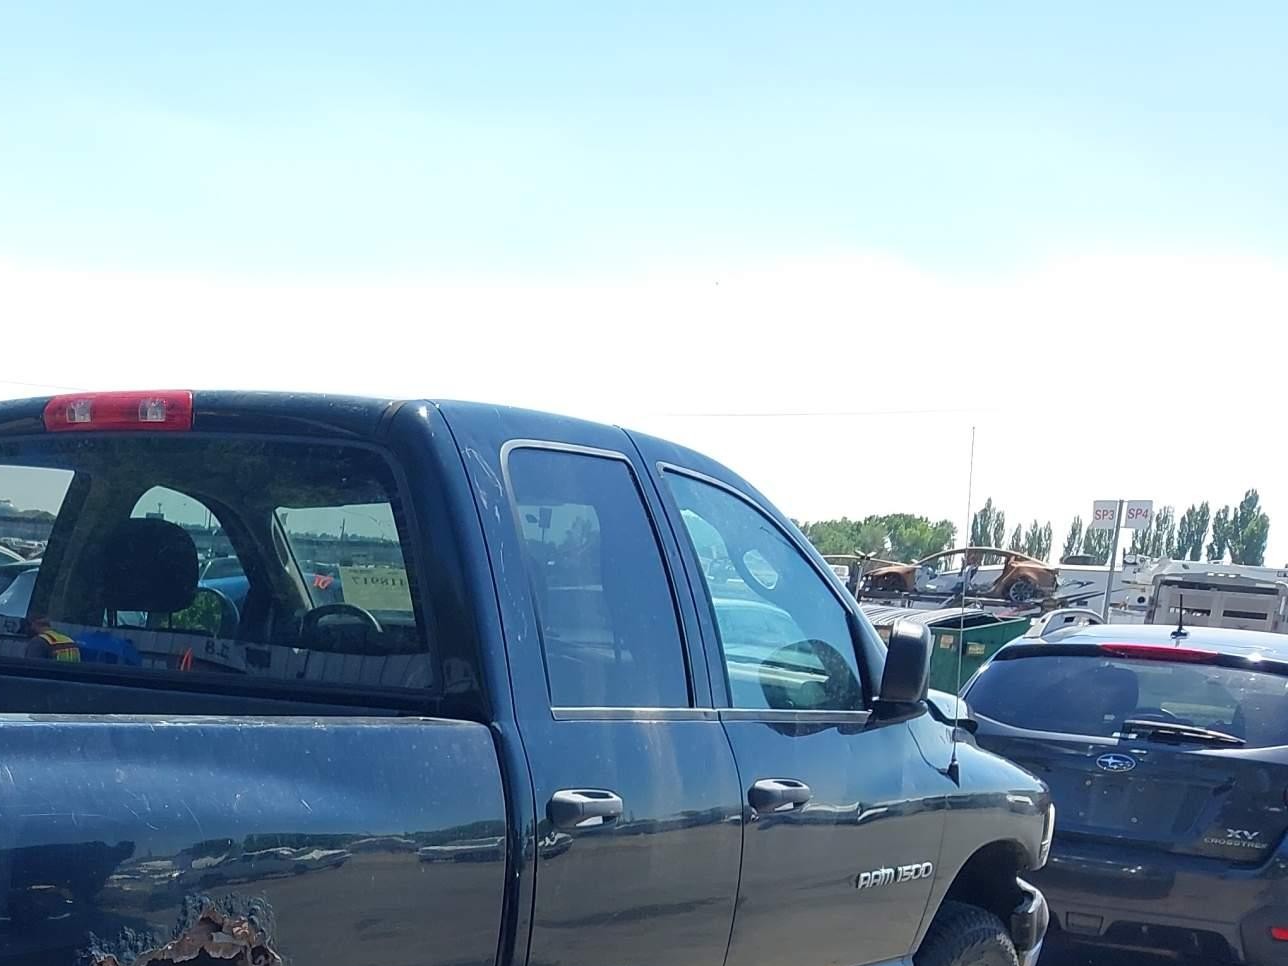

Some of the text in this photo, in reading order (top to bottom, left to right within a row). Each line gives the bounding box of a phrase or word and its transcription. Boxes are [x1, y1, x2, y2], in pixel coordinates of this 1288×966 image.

[1094, 509, 1115, 521] SP3
[1127, 507, 1149, 520] SP4
[1226, 828, 1259, 839] XV
[857, 861, 933, 889] RAM 1500
